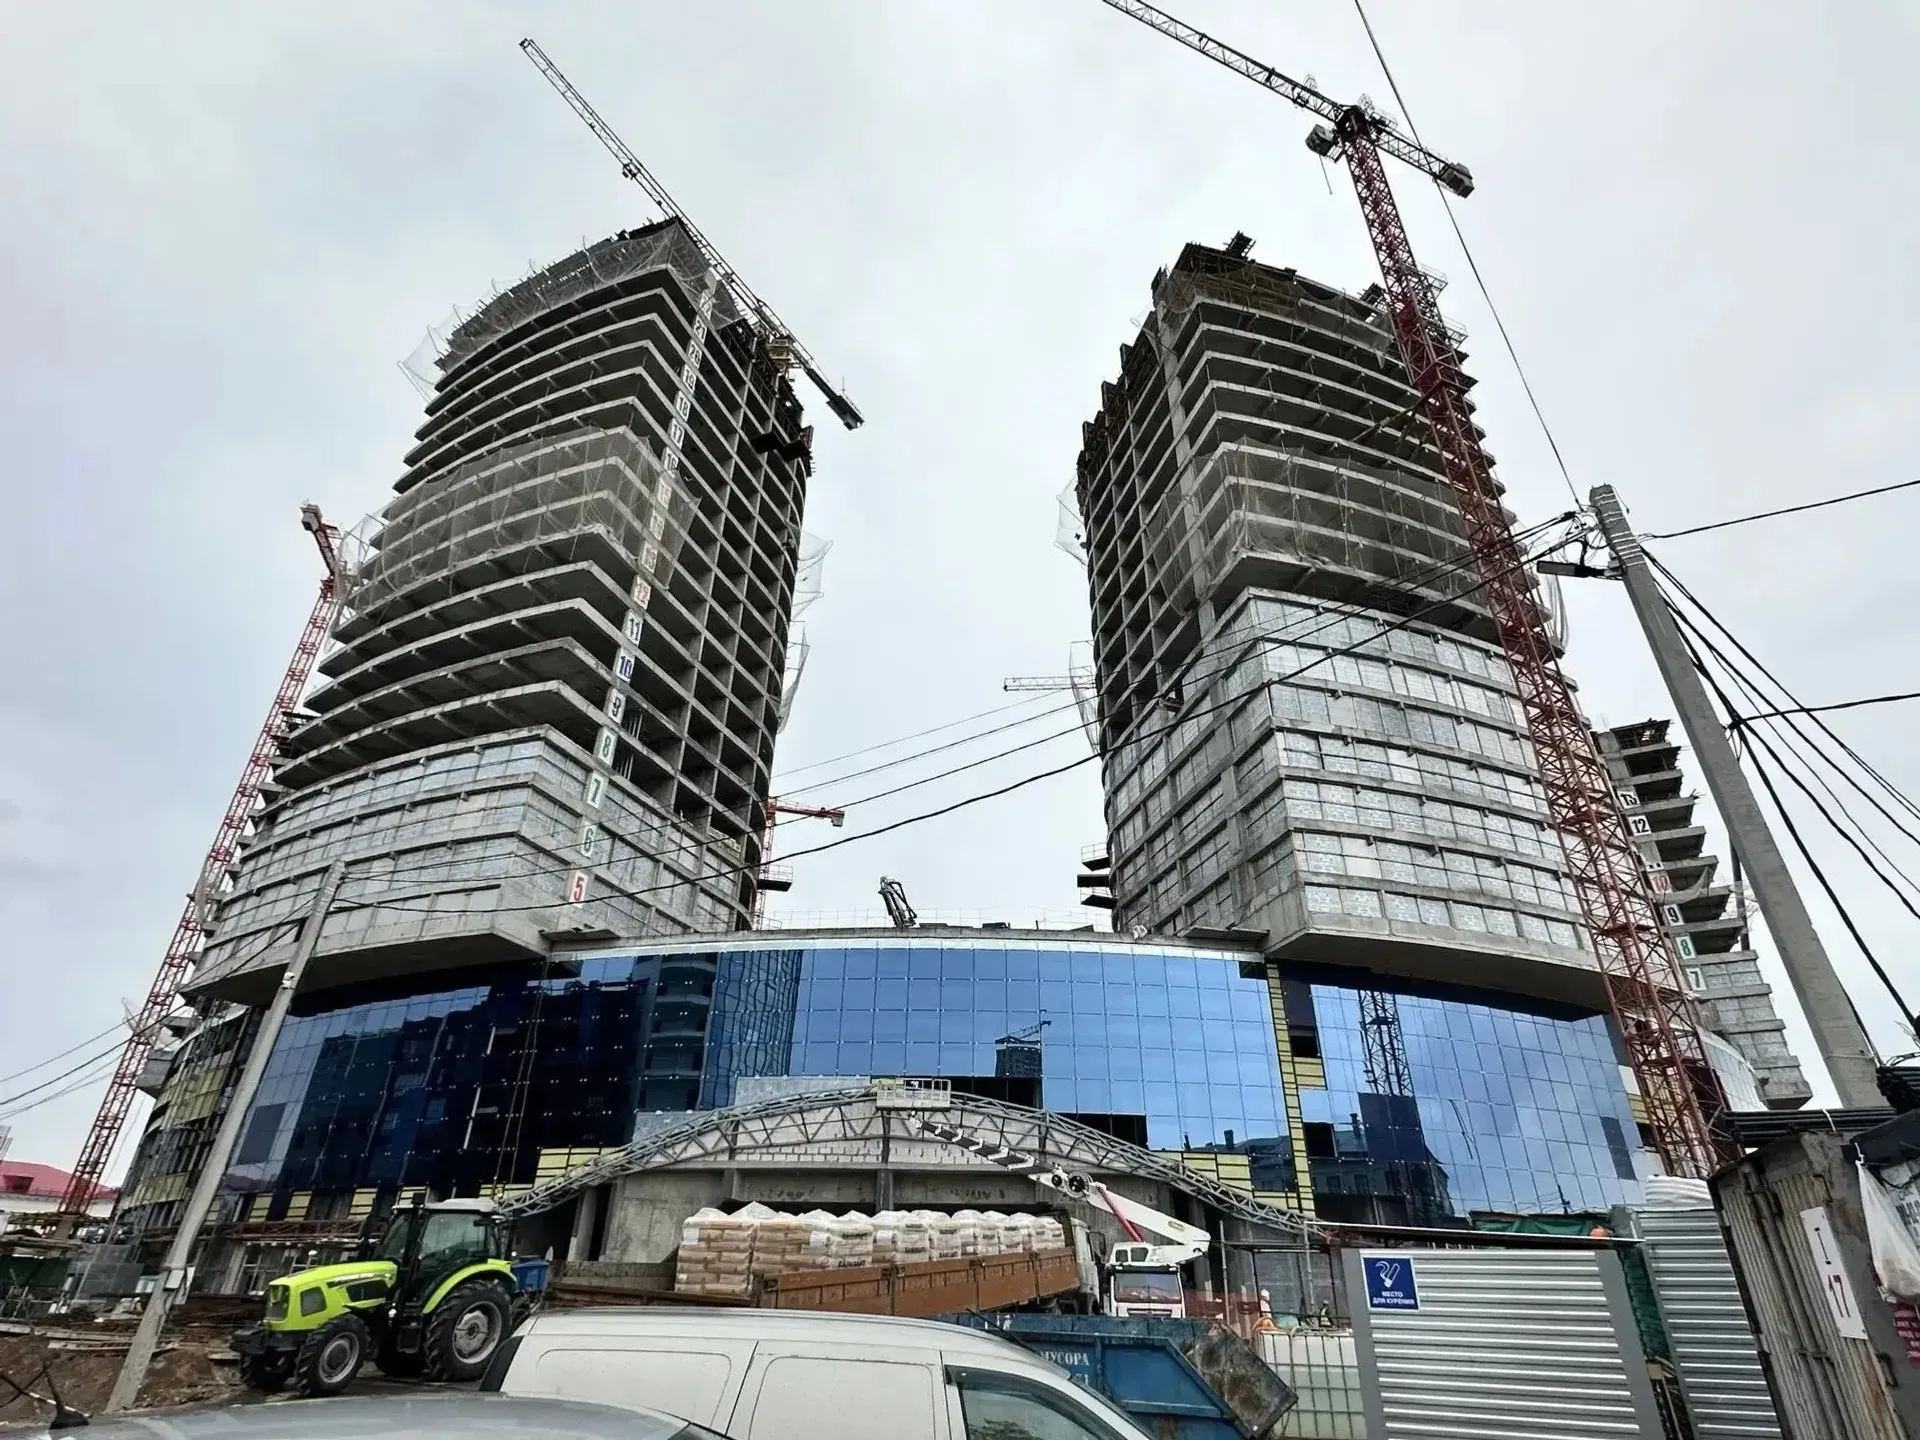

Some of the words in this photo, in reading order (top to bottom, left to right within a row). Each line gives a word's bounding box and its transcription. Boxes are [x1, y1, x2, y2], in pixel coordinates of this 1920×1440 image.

[679, 396, 688, 416] 18
[673, 423, 682, 444] 17
[629, 618, 641, 642] 11
[620, 655, 632, 679] 10
[612, 696, 621, 717] 9
[602, 735, 611, 758] 8
[591, 778, 601, 804] 7
[1631, 818, 1649, 833] 12
[584, 827, 594, 853] 6
[574, 875, 584, 902] 5
[1667, 907, 1679, 923] 9
[1680, 939, 1692, 956] 8
[1689, 970, 1700, 988] 7
[1828, 1274, 1851, 1318] 17
